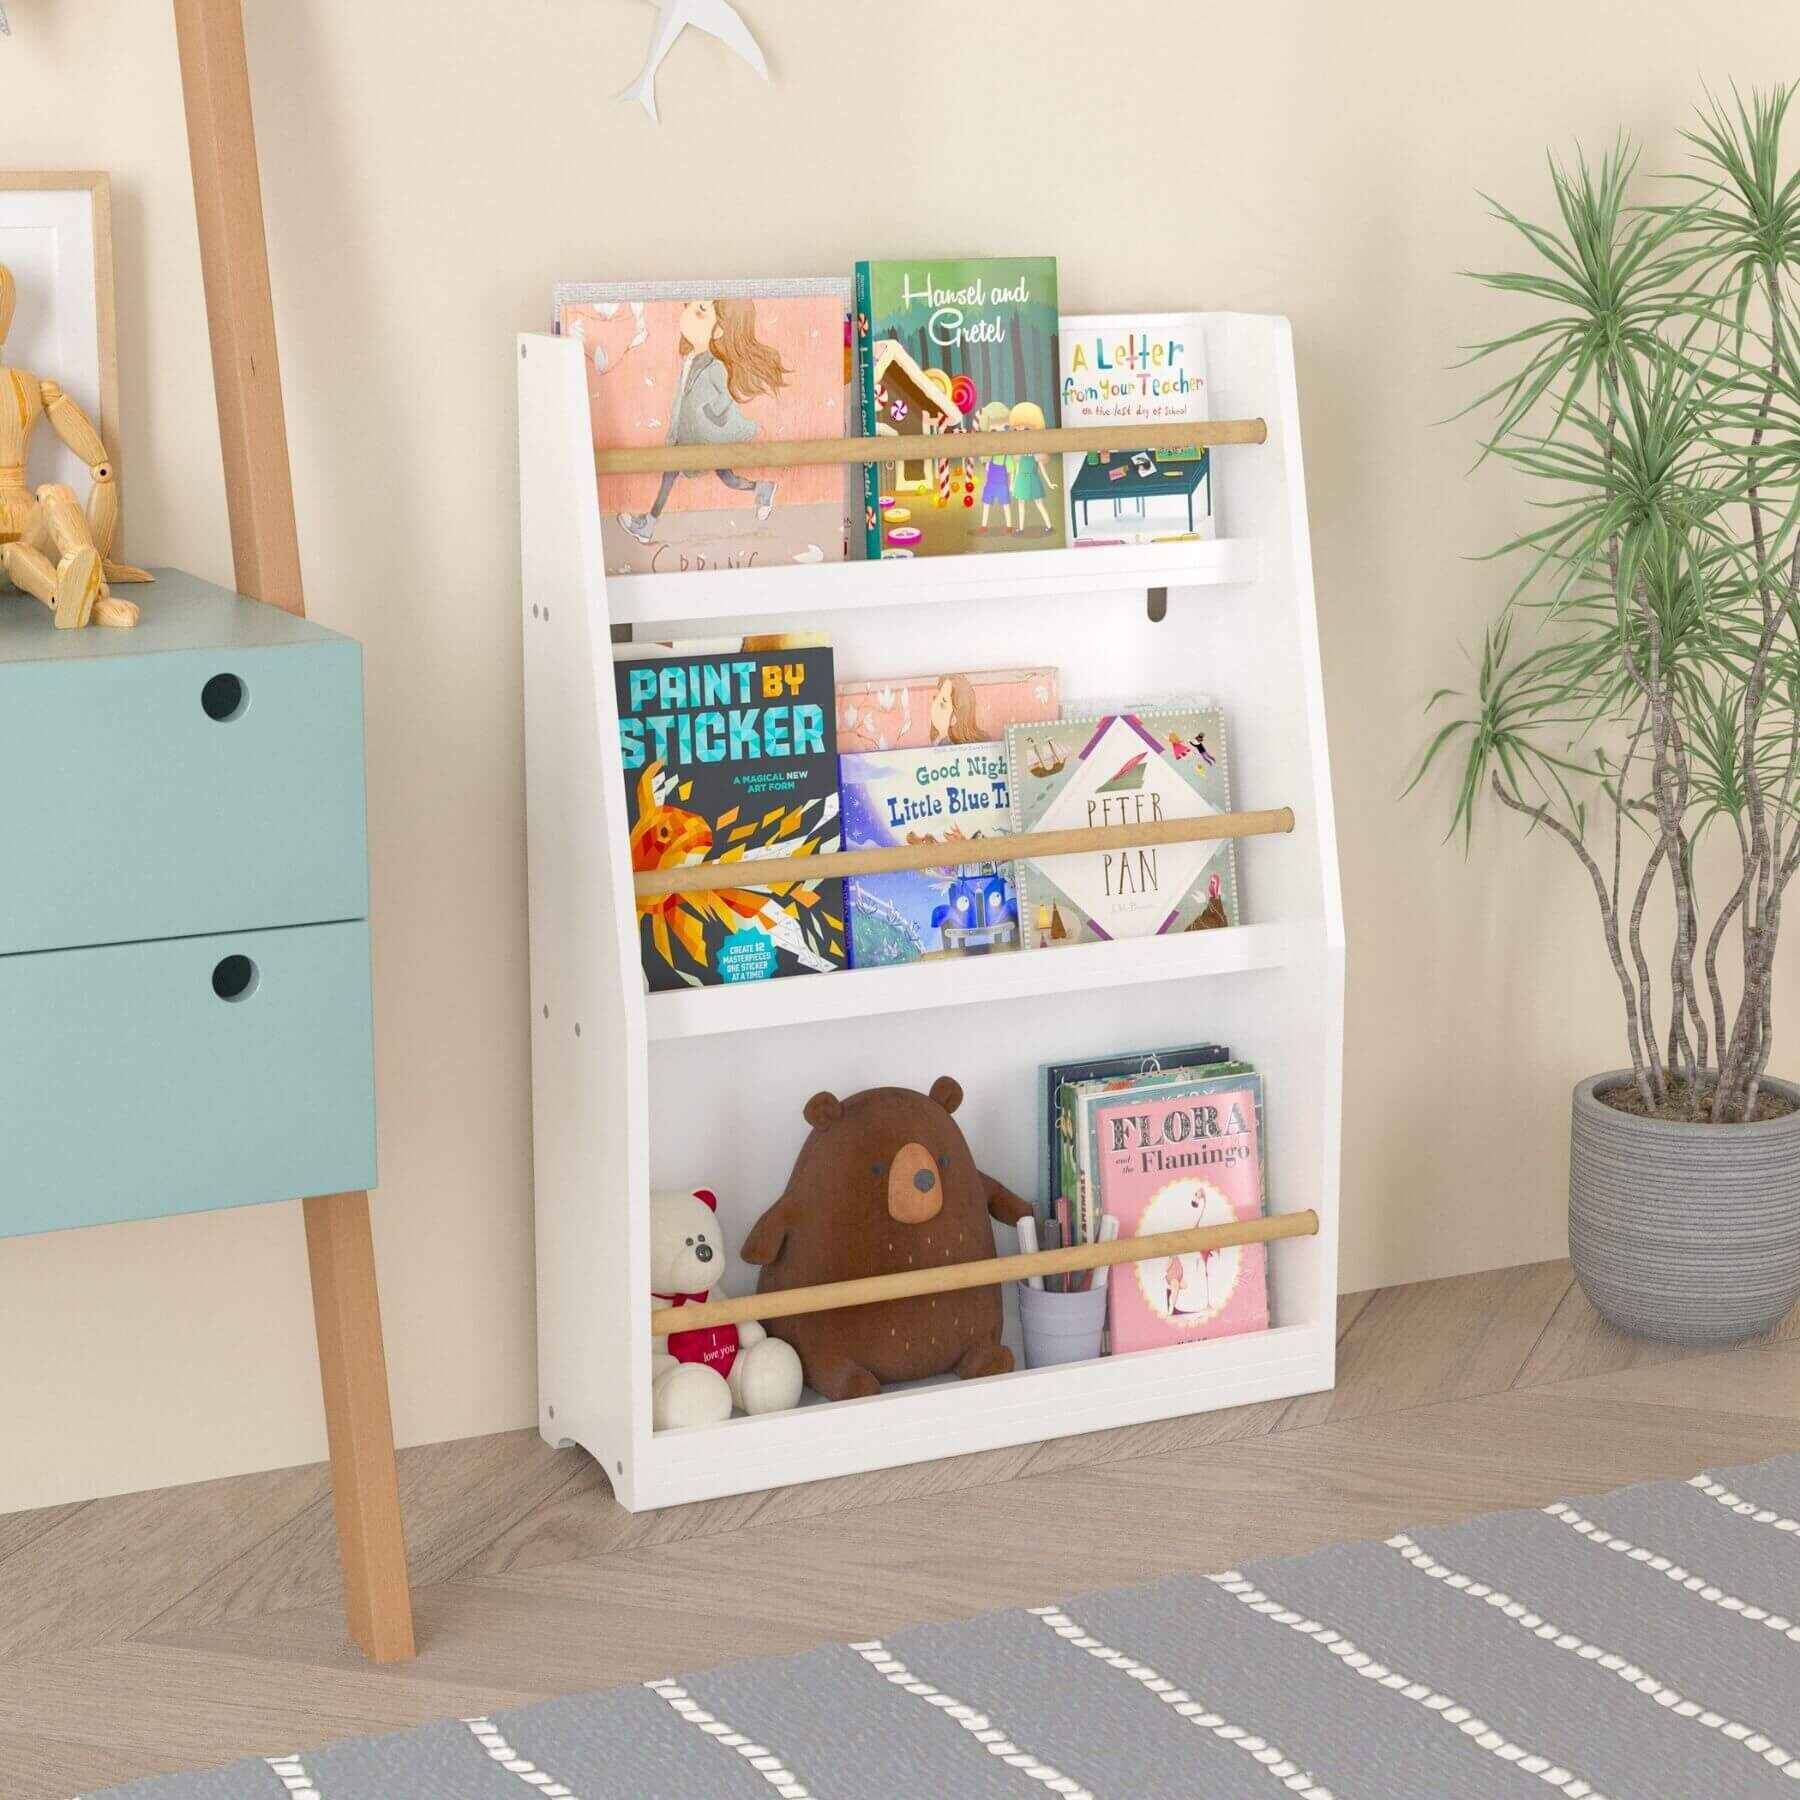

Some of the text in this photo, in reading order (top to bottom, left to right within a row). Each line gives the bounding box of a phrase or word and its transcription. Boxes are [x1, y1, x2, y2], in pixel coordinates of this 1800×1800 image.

[901, 272, 986, 310] Hansel
[990, 276, 1029, 305] and
[928, 307, 1005, 348] Gretel
[1072, 333, 1184, 373] A Letter
[1062, 377, 1098, 405] from
[1136, 368, 1204, 396] Teacher
[1096, 405, 1110, 416] the
[1113, 403, 1131, 416] last
[629, 662, 805, 712] PAINT BY
[620, 703, 826, 770] STICKER
[733, 770, 808, 784] A MAGICAL NEW
[747, 781, 795, 793] ART FORM
[916, 756, 1008, 785] Good Nigh
[887, 794, 943, 827] Little
[946, 786, 990, 814] Blue
[1087, 793, 1164, 828] PETER
[1103, 849, 1159, 896] PAN
[730, 942, 765, 954] CREATE 12
[726, 960, 768, 973] ONE STICKER
[1110, 1102, 1252, 1151] FLORA
[1141, 1144, 1250, 1173] Flamingo
[704, 1344, 735, 1362] love you
[712, 1333, 717, 1347] I
